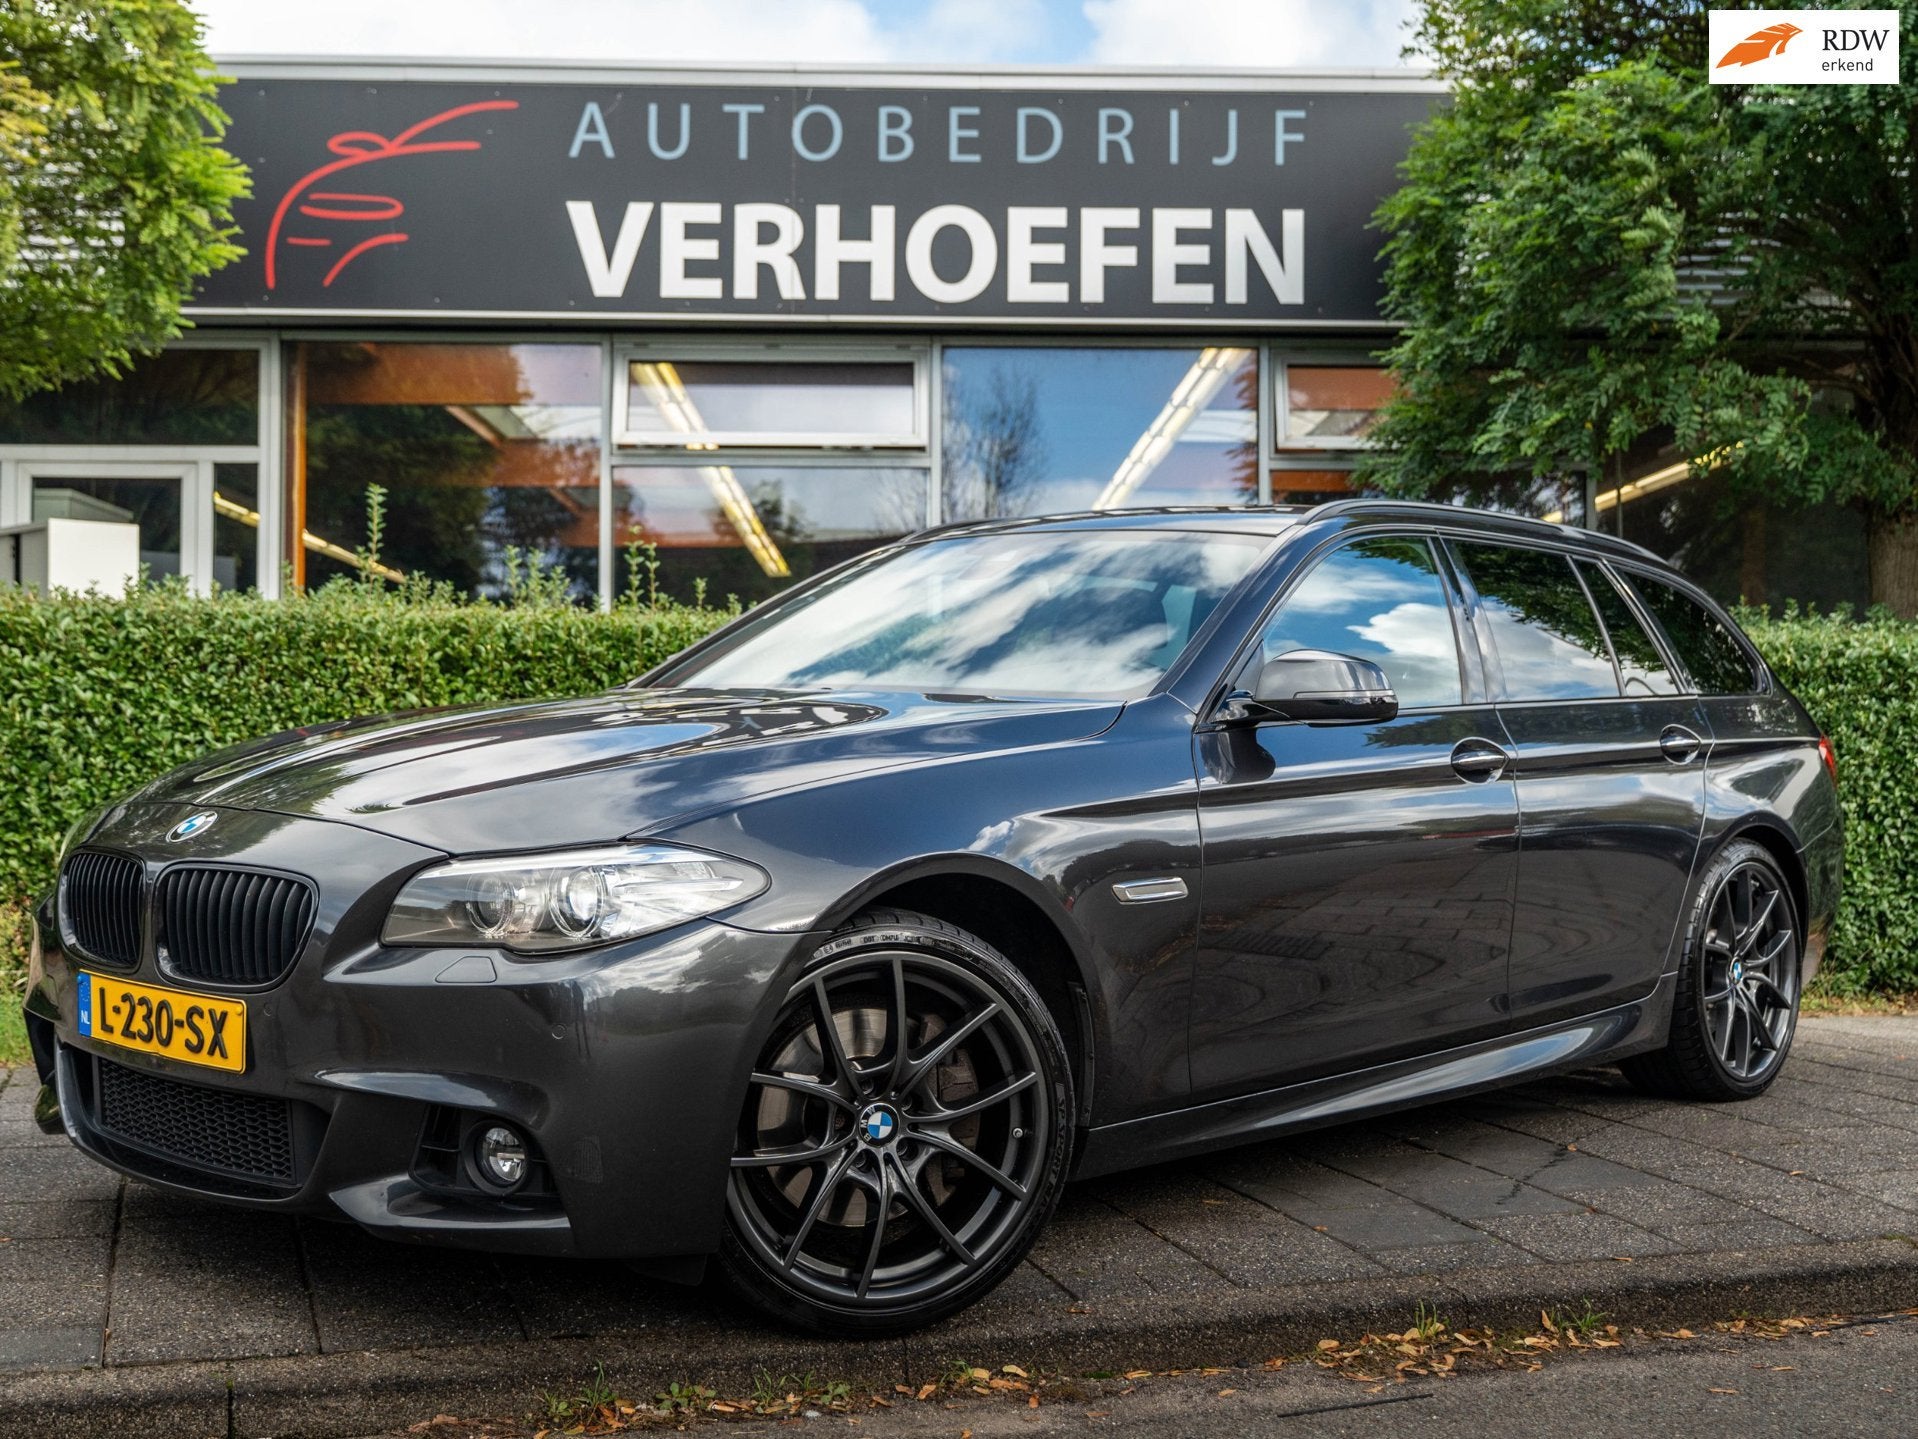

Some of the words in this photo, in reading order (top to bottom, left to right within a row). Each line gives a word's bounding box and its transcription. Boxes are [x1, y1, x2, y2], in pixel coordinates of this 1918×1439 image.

[568, 101, 1307, 167] AUTOBEDRIJF
[565, 201, 1305, 305] VERHOEFEN
[80, 1010, 90, 1025] NL
[99, 987, 228, 1059] L-230-SX
